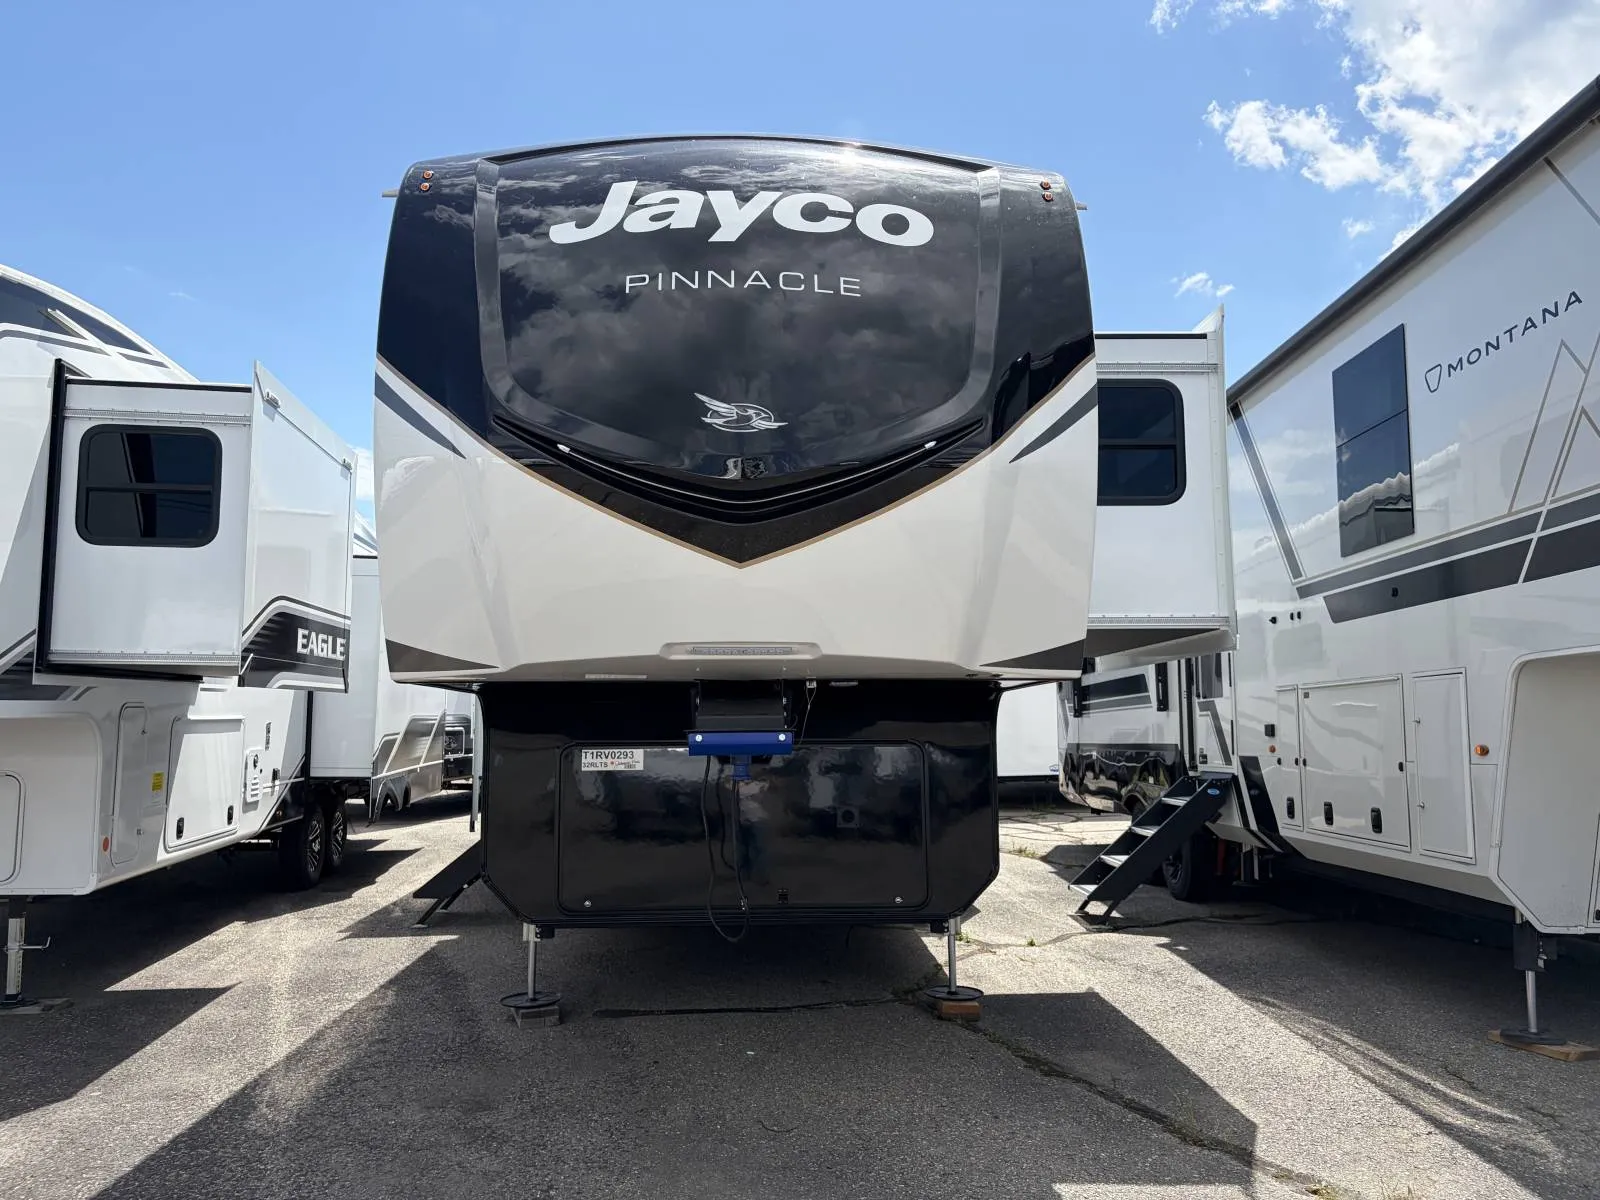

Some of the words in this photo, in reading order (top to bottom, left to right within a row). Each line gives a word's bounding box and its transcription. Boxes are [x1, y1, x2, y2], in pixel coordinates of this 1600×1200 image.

[549, 180, 934, 247] Jayco
[625, 270, 861, 297] PINNACLE
[1447, 290, 1582, 378] MONTANA
[296, 627, 346, 661] EAGLE
[583, 751, 634, 760] T1RV0293
